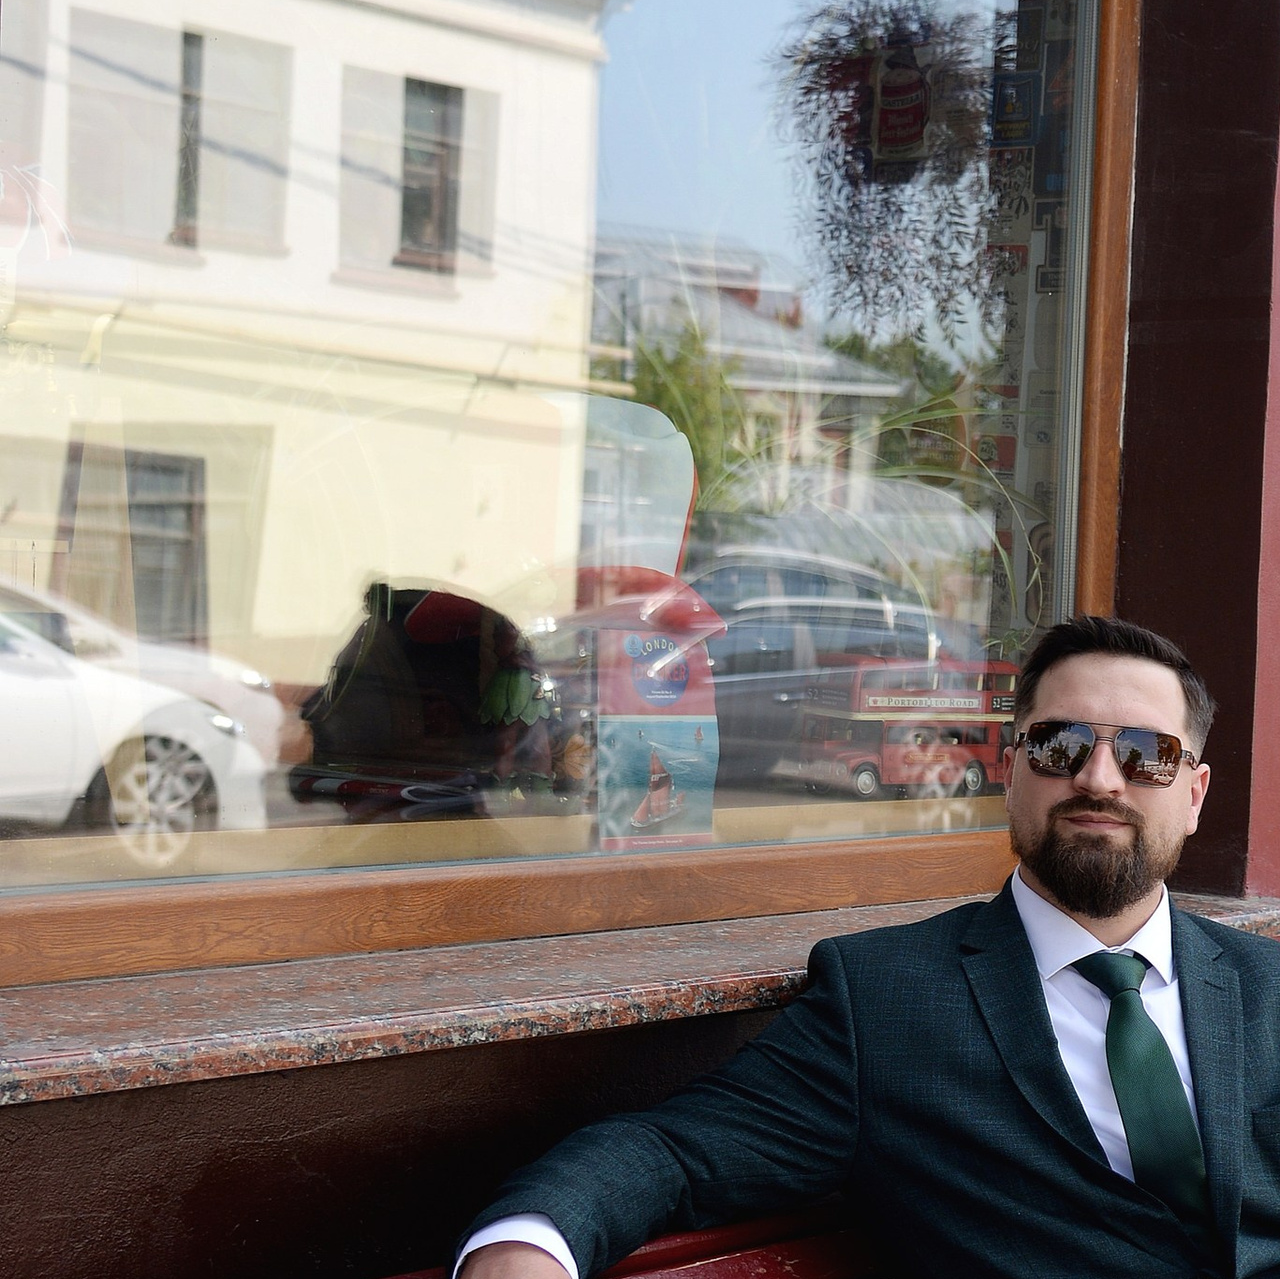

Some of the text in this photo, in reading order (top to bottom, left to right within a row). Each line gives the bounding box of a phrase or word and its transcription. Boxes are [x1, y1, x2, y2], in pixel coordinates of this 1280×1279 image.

[641, 639, 678, 657] LONDO
[807, 688, 819, 700] 52
[887, 697, 974, 708] PORTOBELLO ROAD
[992, 697, 1001, 709] 52
